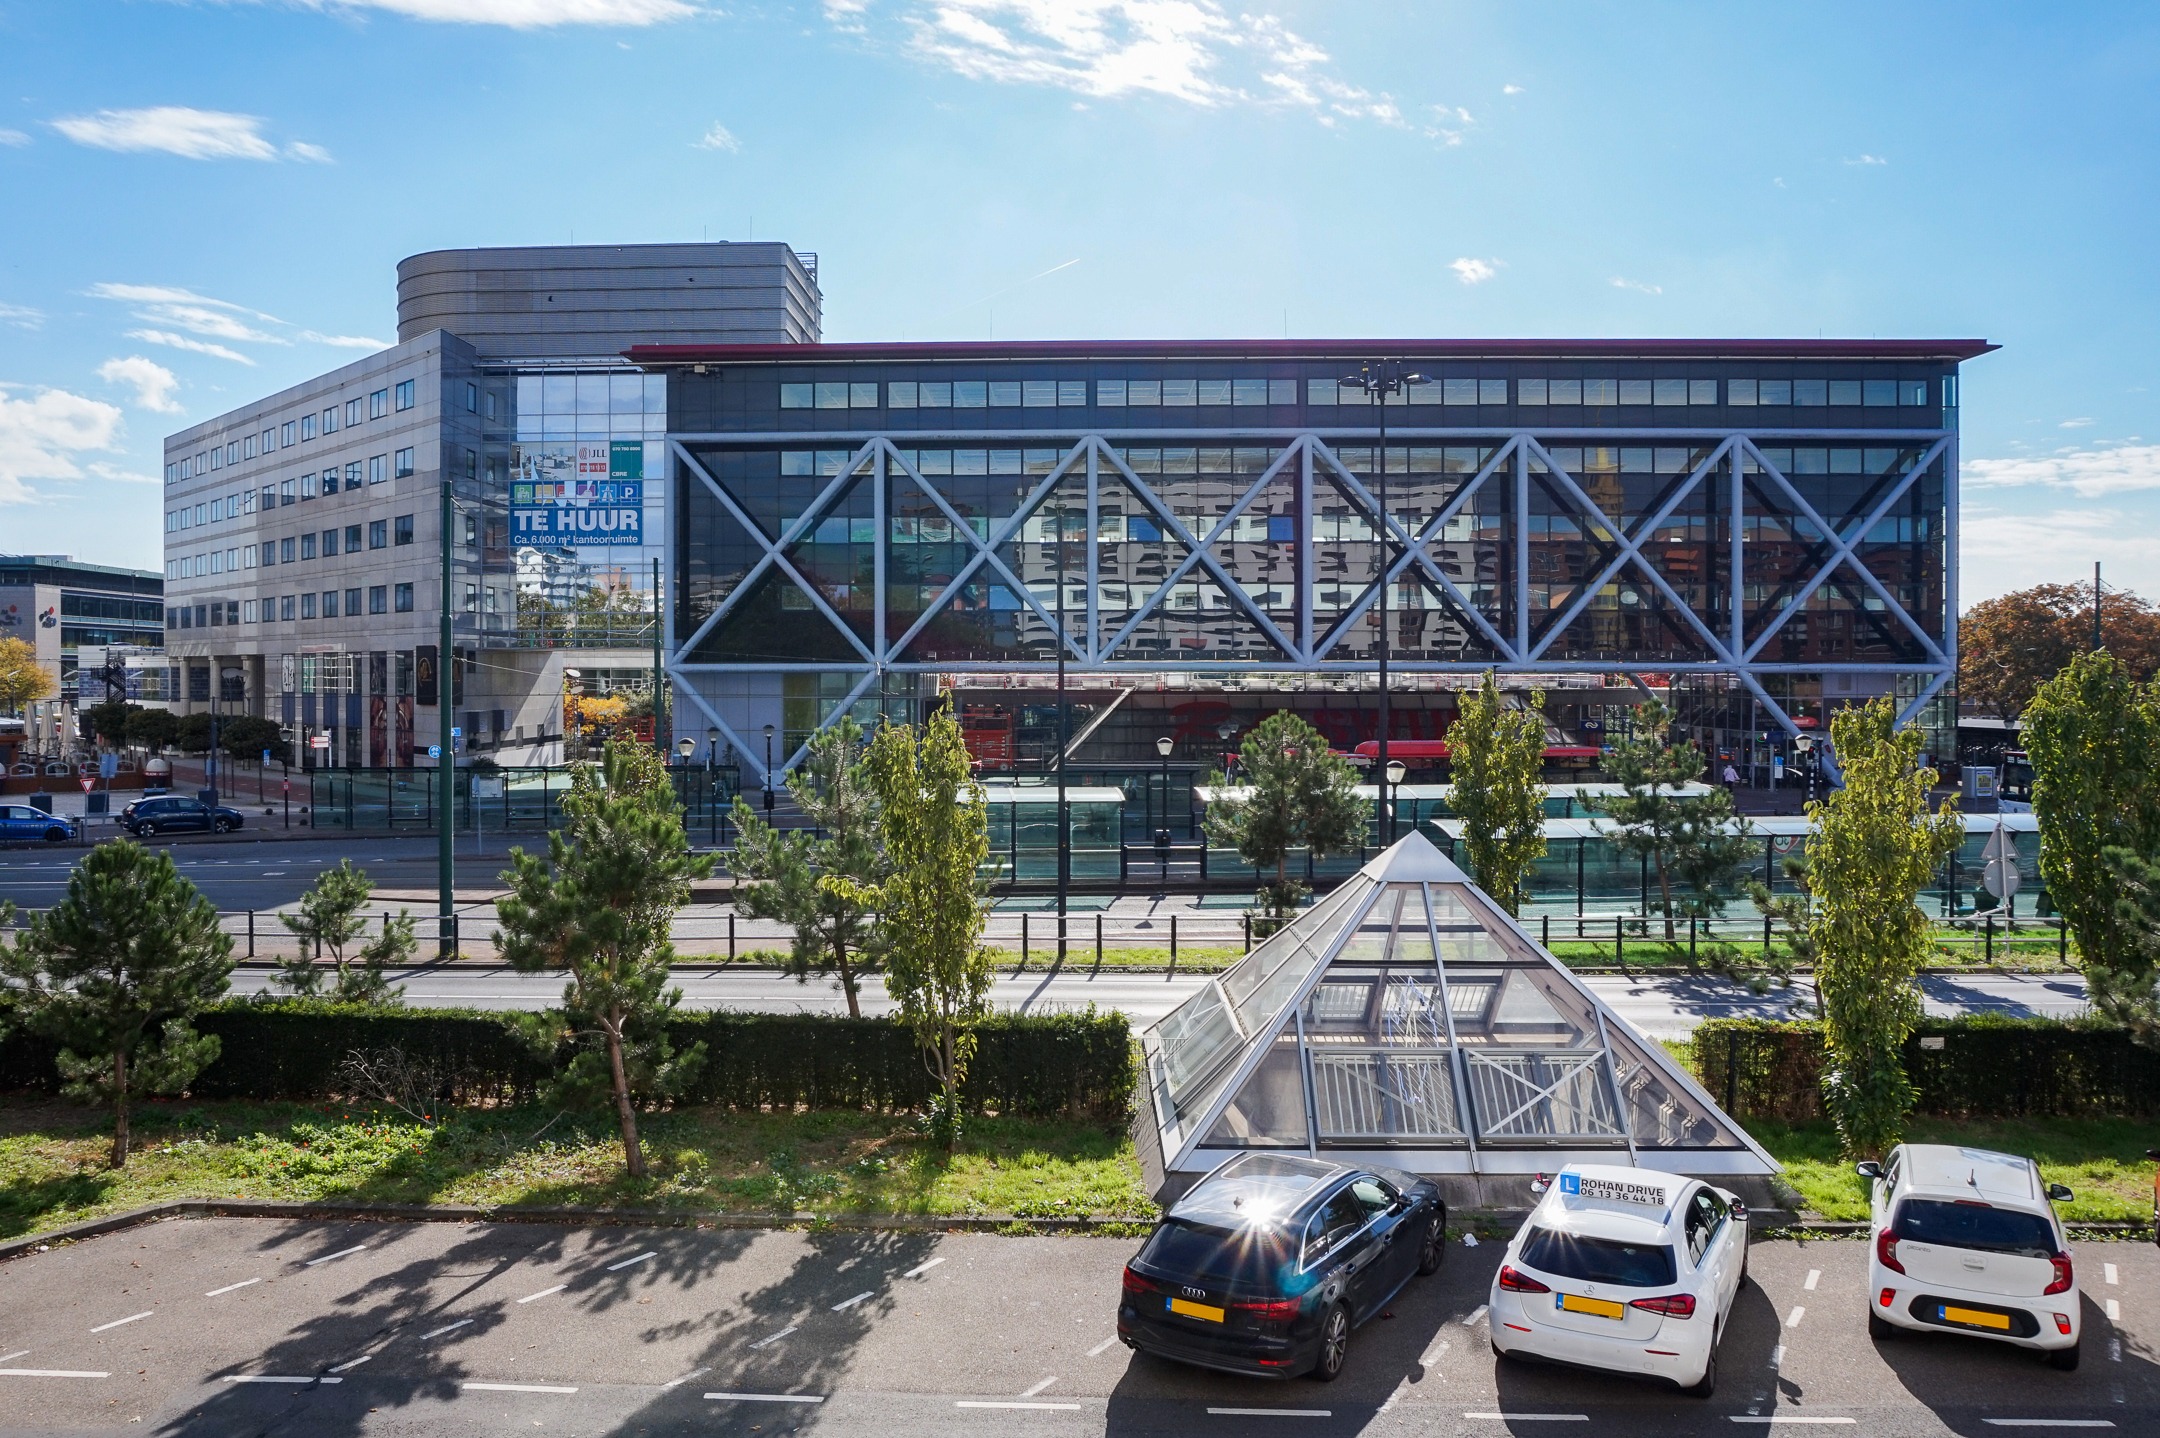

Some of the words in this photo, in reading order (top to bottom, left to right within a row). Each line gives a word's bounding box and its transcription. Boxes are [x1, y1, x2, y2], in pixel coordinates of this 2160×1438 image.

[591, 449, 607, 458] JLL
[514, 510, 549, 531] TE
[557, 510, 638, 531] HUUR
[514, 535, 530, 544] Ca.
[531, 535, 556, 544] 6.000
[573, 534, 638, 544] kantoorruimte
[1565, 1177, 1574, 1191] L
[1581, 1179, 1624, 1192] ROHAN
[1627, 1184, 1663, 1197] DRIVE
[1580, 1187, 1594, 1196] 06
[1599, 1190, 1611, 1199] 13
[1615, 1191, 1629, 1201] 36
[1633, 1194, 1646, 1203] 44
[1651, 1196, 1664, 1205] 18
